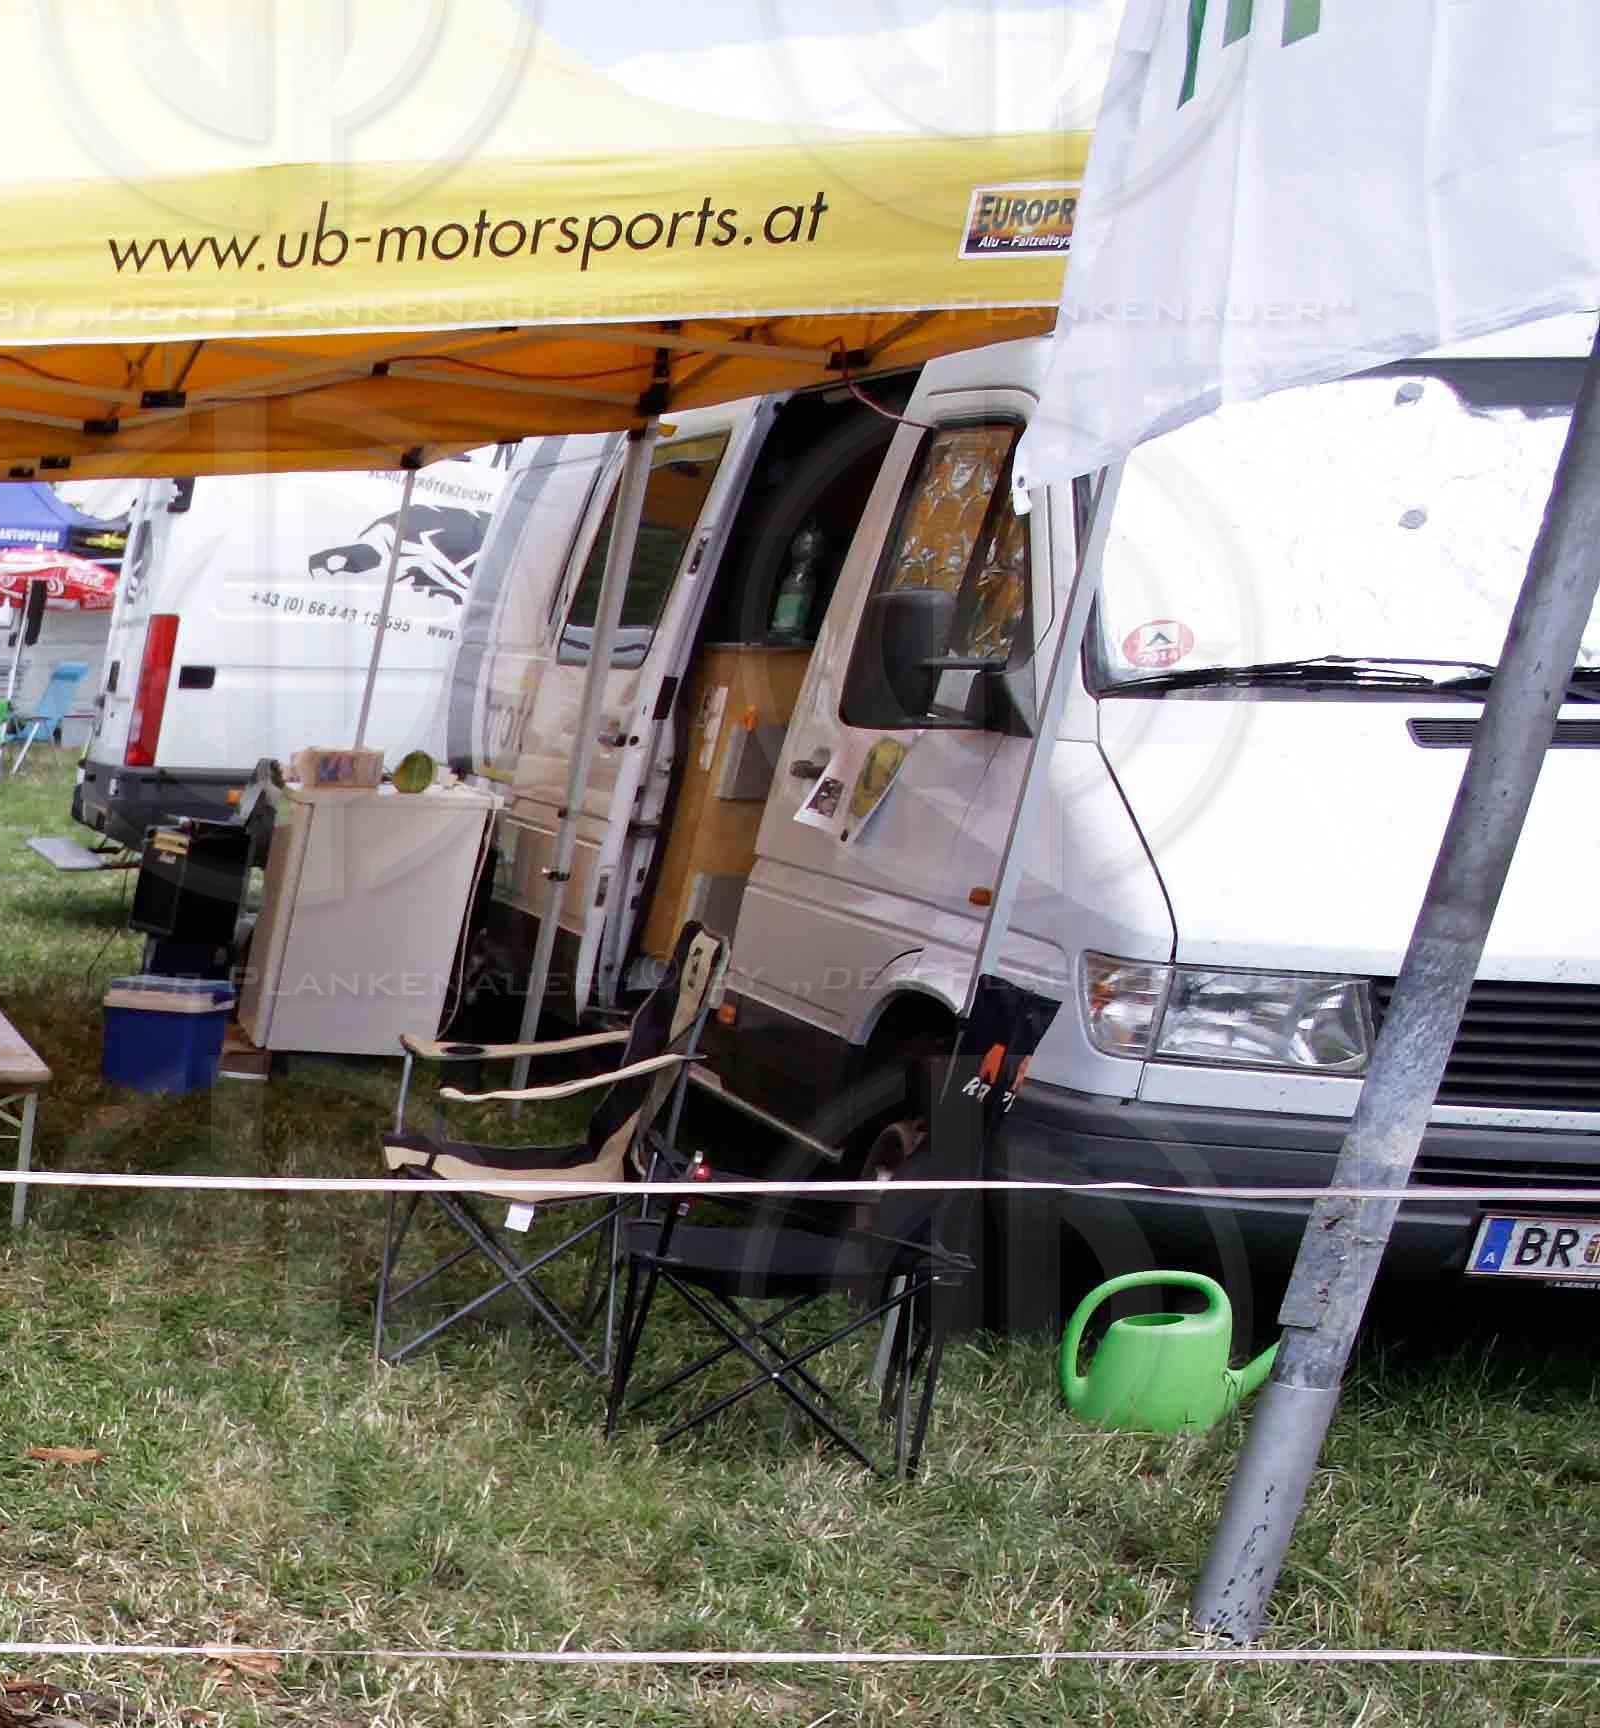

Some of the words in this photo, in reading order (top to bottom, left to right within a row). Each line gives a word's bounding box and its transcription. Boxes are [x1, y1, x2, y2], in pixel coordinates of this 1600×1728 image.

[108, 191, 828, 273] www.ub-motorsports.at
[977, 195, 1078, 231] EUROPR
[1512, 1226, 1580, 1268] BR
